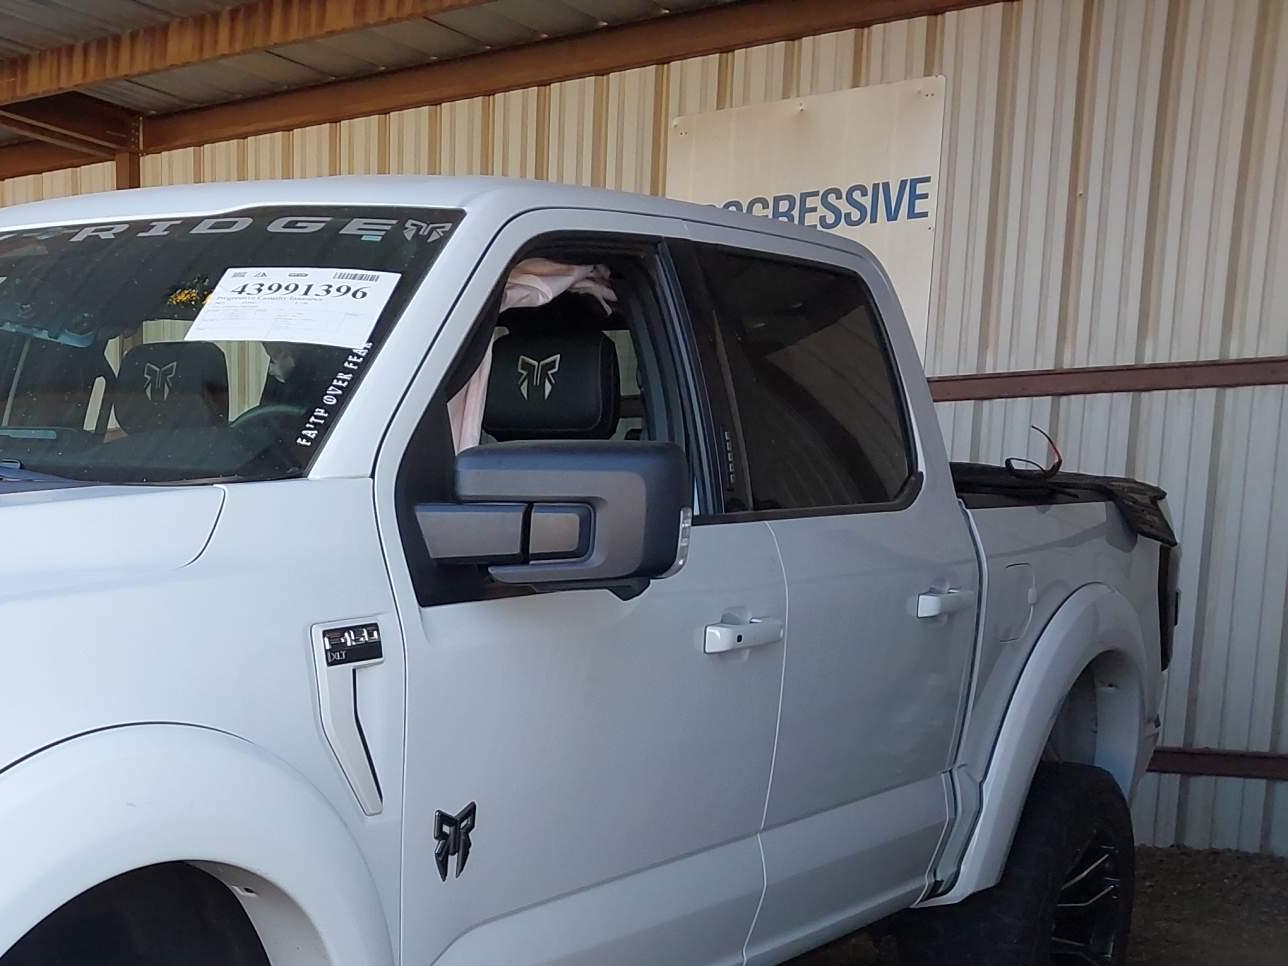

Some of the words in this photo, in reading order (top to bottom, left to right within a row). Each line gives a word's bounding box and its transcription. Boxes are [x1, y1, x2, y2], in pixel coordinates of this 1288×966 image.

[68, 216, 399, 242] RIDGE
[231, 282, 372, 300] 43991396
[296, 407, 329, 446] FAITH
[323, 372, 353, 405] OVER
